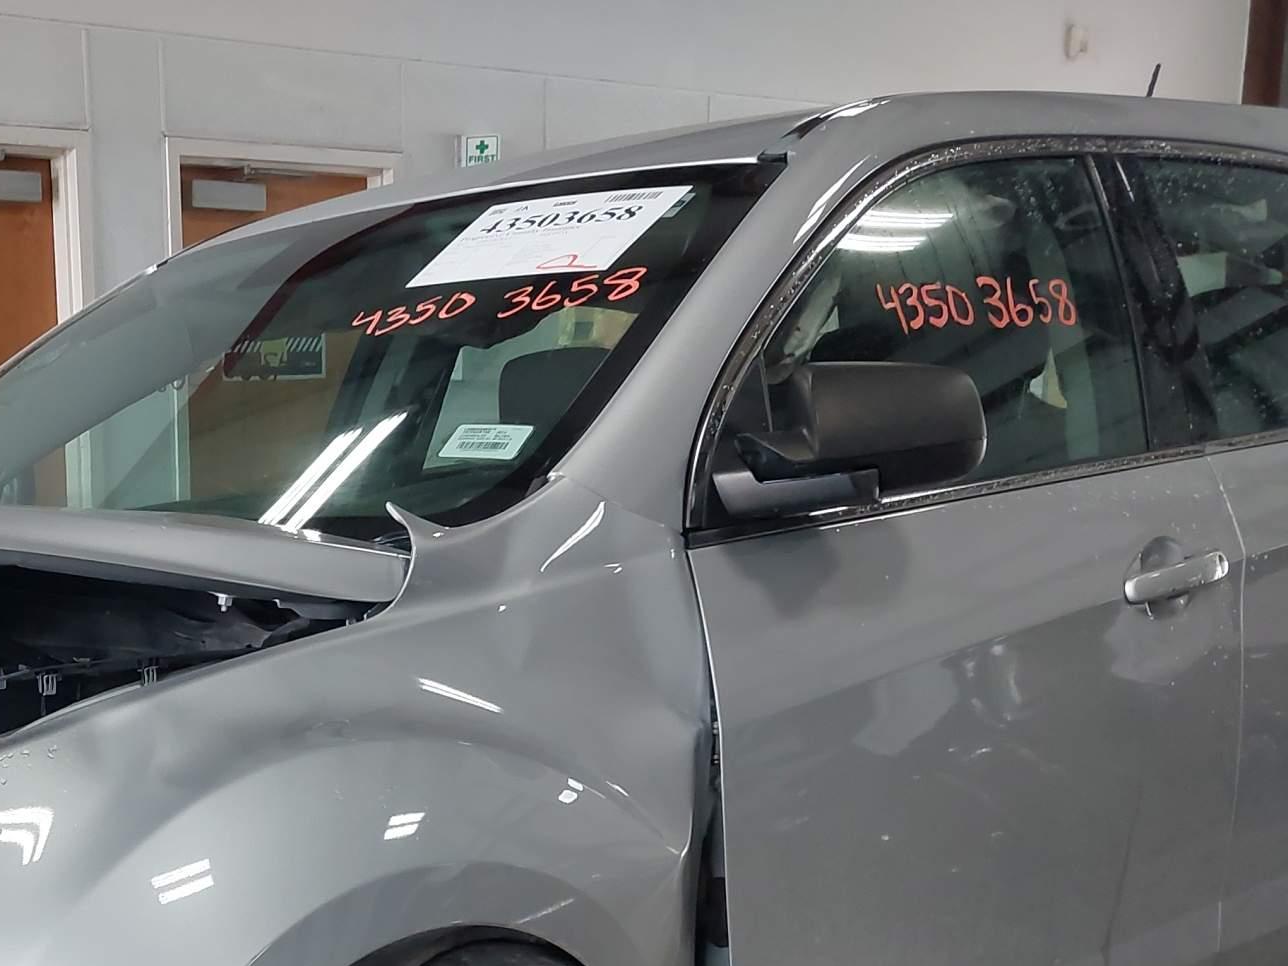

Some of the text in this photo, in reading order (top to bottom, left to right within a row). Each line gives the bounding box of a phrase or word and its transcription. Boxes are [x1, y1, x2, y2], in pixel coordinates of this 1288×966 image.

[480, 204, 644, 235] 43503658
[352, 265, 649, 336] 4350 3658
[876, 275, 1077, 335] 4350 3658
